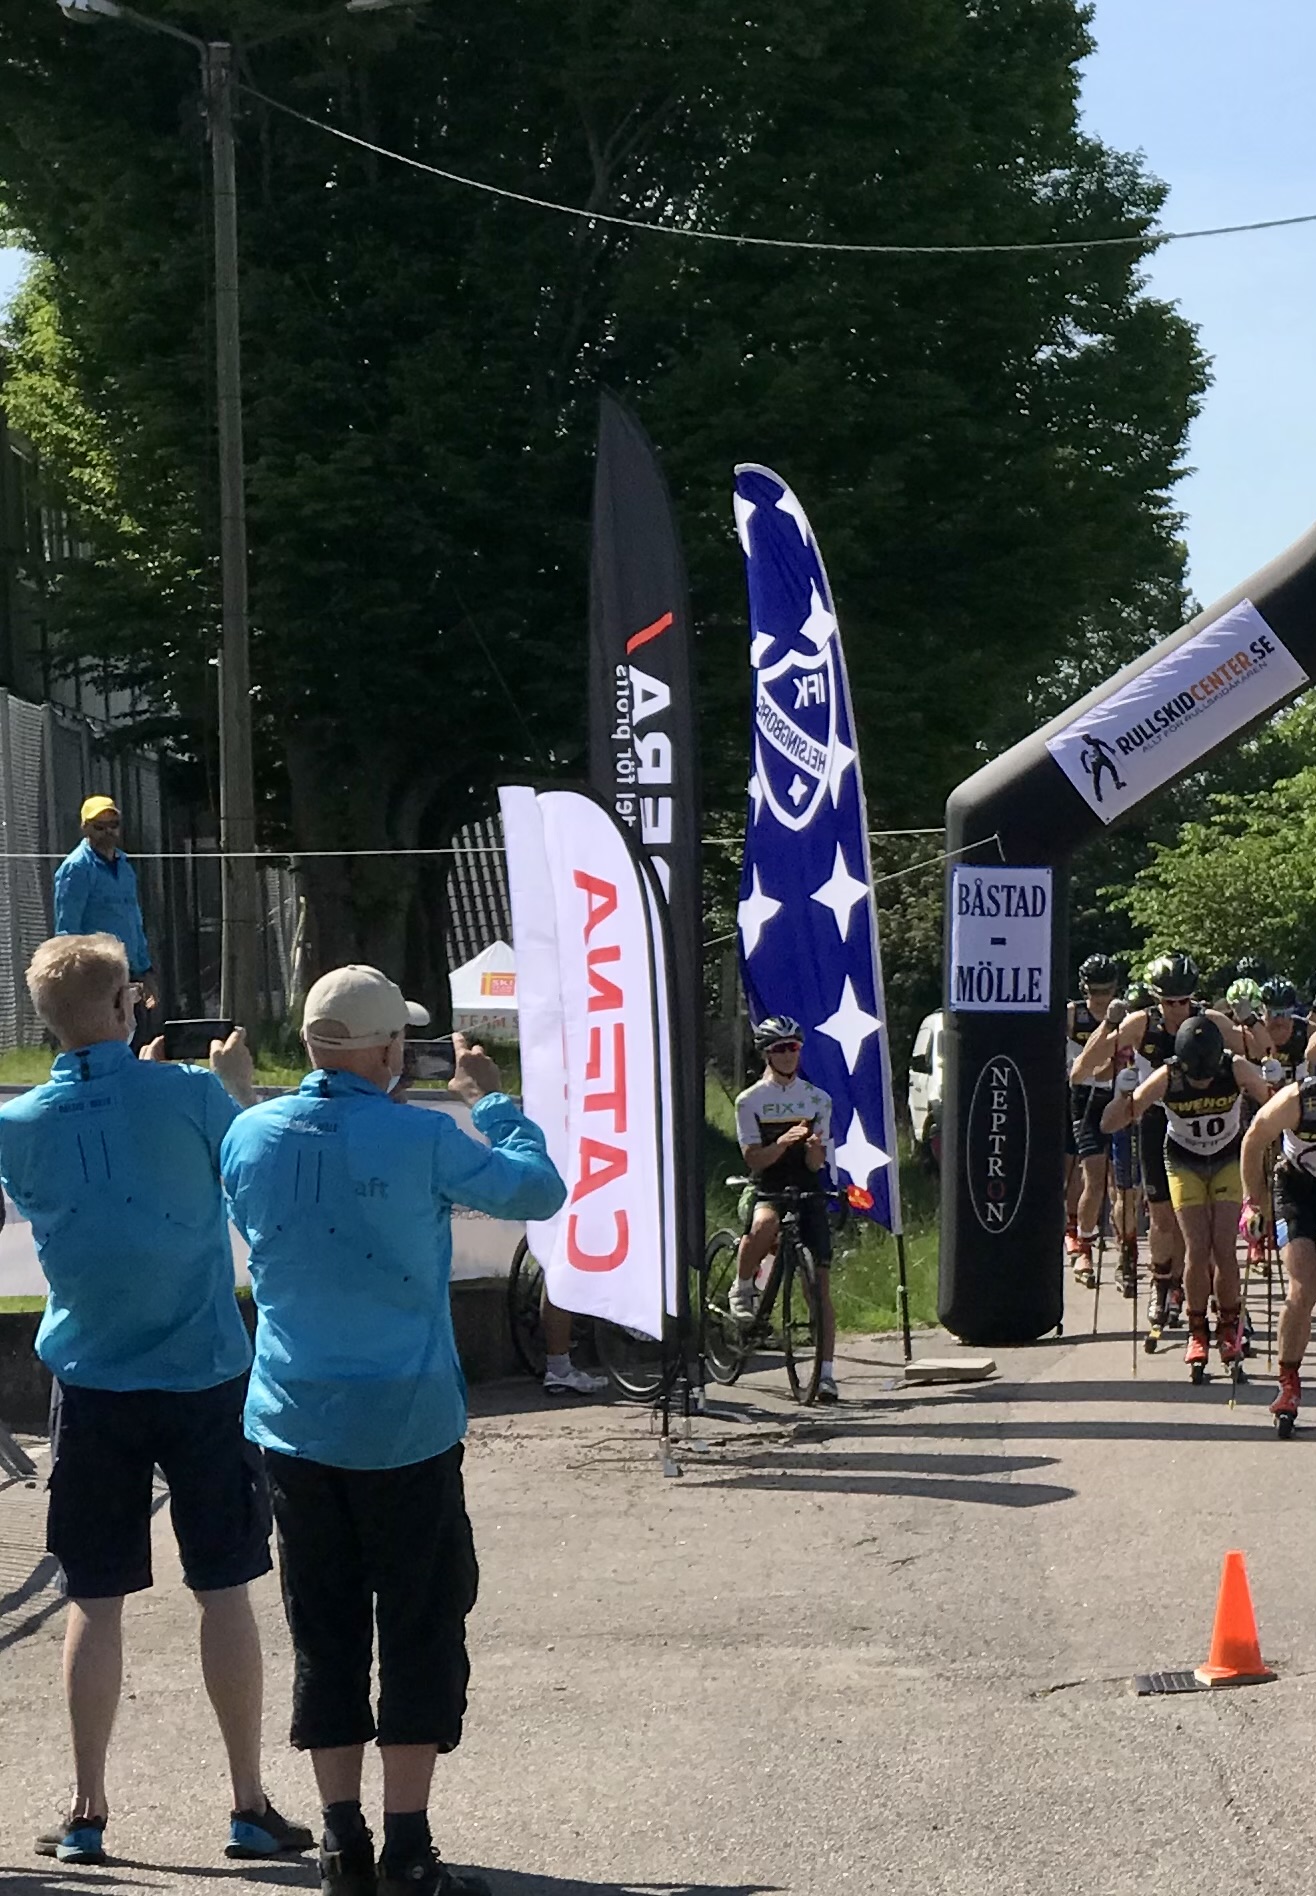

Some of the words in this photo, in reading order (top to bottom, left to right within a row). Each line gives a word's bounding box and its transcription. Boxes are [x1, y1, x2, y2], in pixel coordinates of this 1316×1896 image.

[1115, 635, 1276, 755] RULLSKIDCENTER.SE
[958, 878, 1046, 918] BÅSTAD
[956, 961, 1042, 1004] MÖLLE
[763, 1103, 794, 1115] FIX
[1187, 1117, 1225, 1137] 10
[987, 1067, 1011, 1222] NEPTRON
